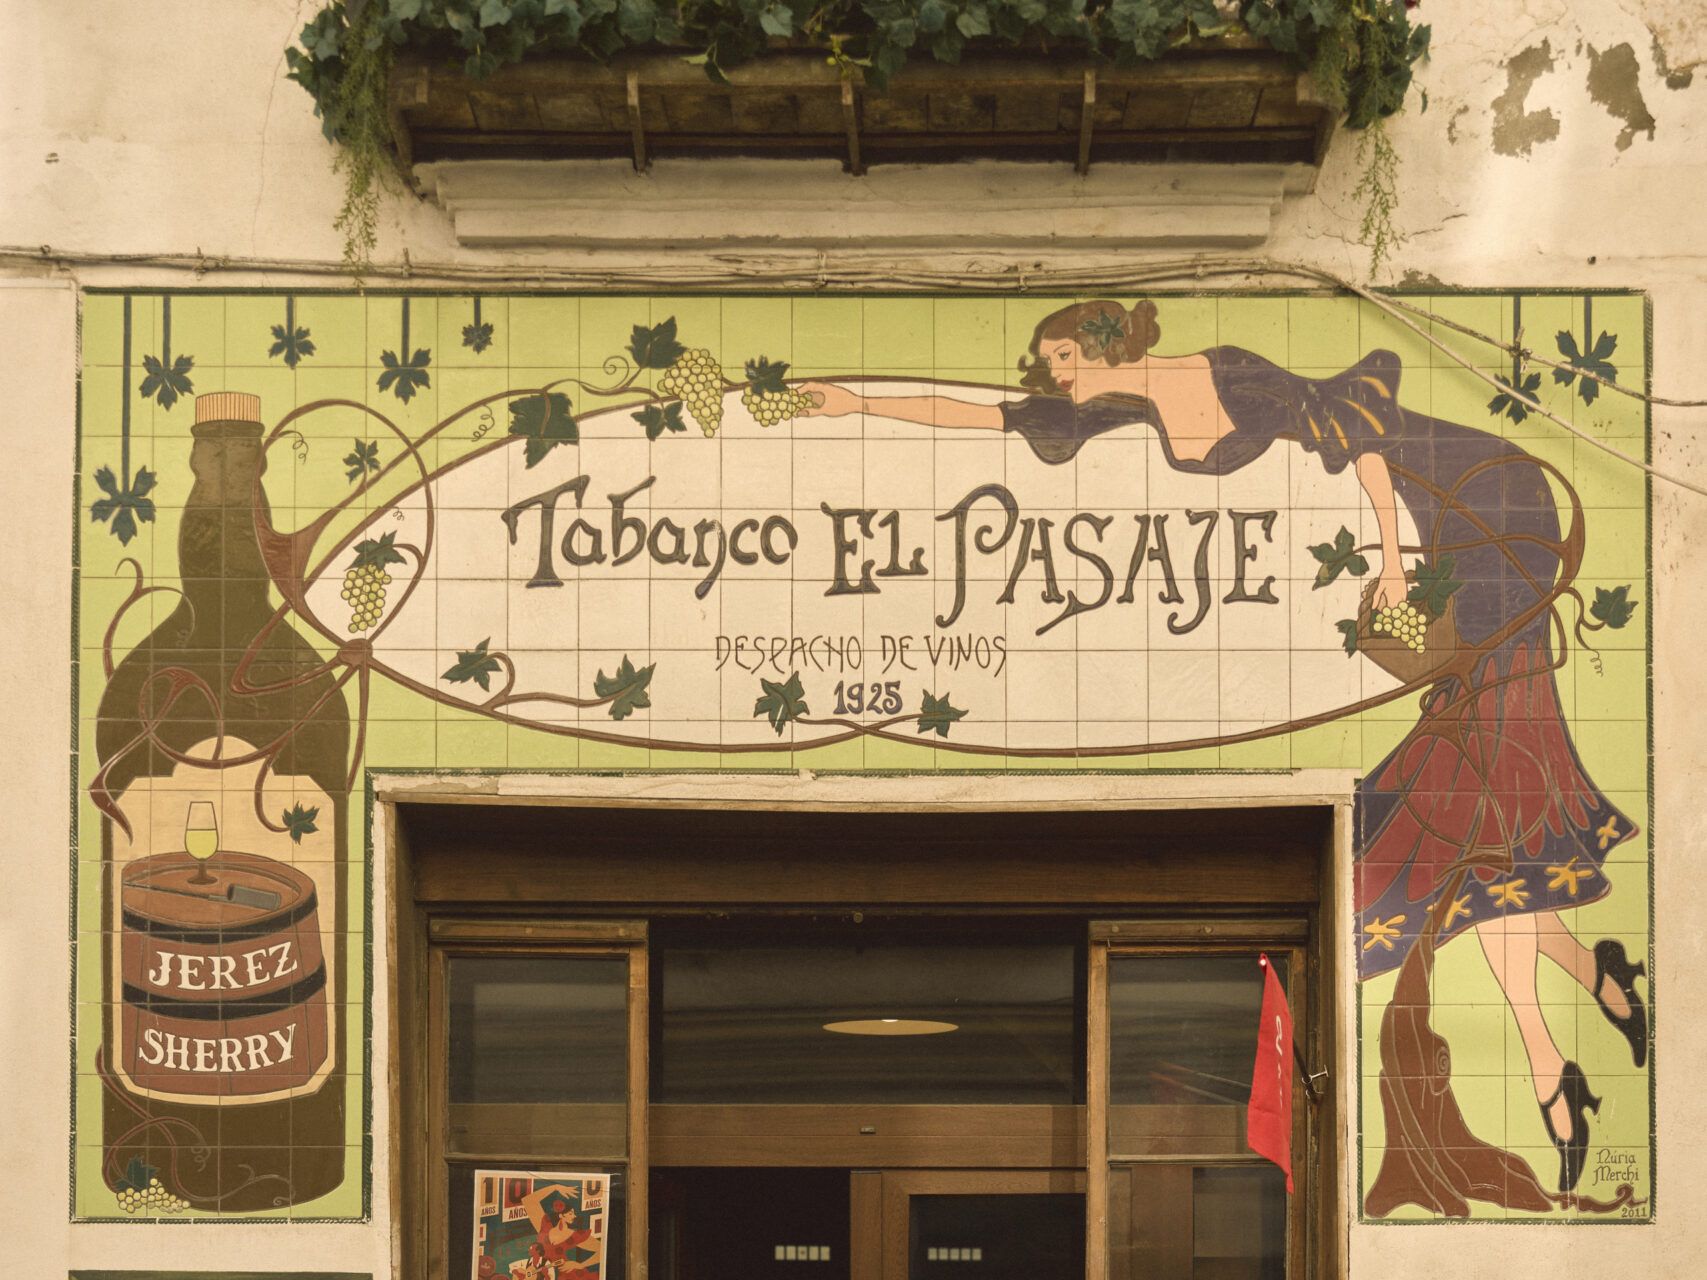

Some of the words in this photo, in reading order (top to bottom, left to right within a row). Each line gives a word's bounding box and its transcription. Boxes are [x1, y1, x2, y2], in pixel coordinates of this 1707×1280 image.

[501, 474, 798, 599] Tabanco
[820, 501, 929, 597] EL
[934, 483, 1280, 636] PASAJE
[715, 635, 862, 674] DESPACHO
[880, 635, 917, 674] DE
[924, 633, 1007, 678] VINOS
[833, 680, 903, 715] 1925
[148, 941, 298, 990] JEREZ
[138, 1023, 297, 1072] SHERRY
[1592, 1165, 1640, 1186] Merchi
[1621, 1207, 1648, 1218] 2011
